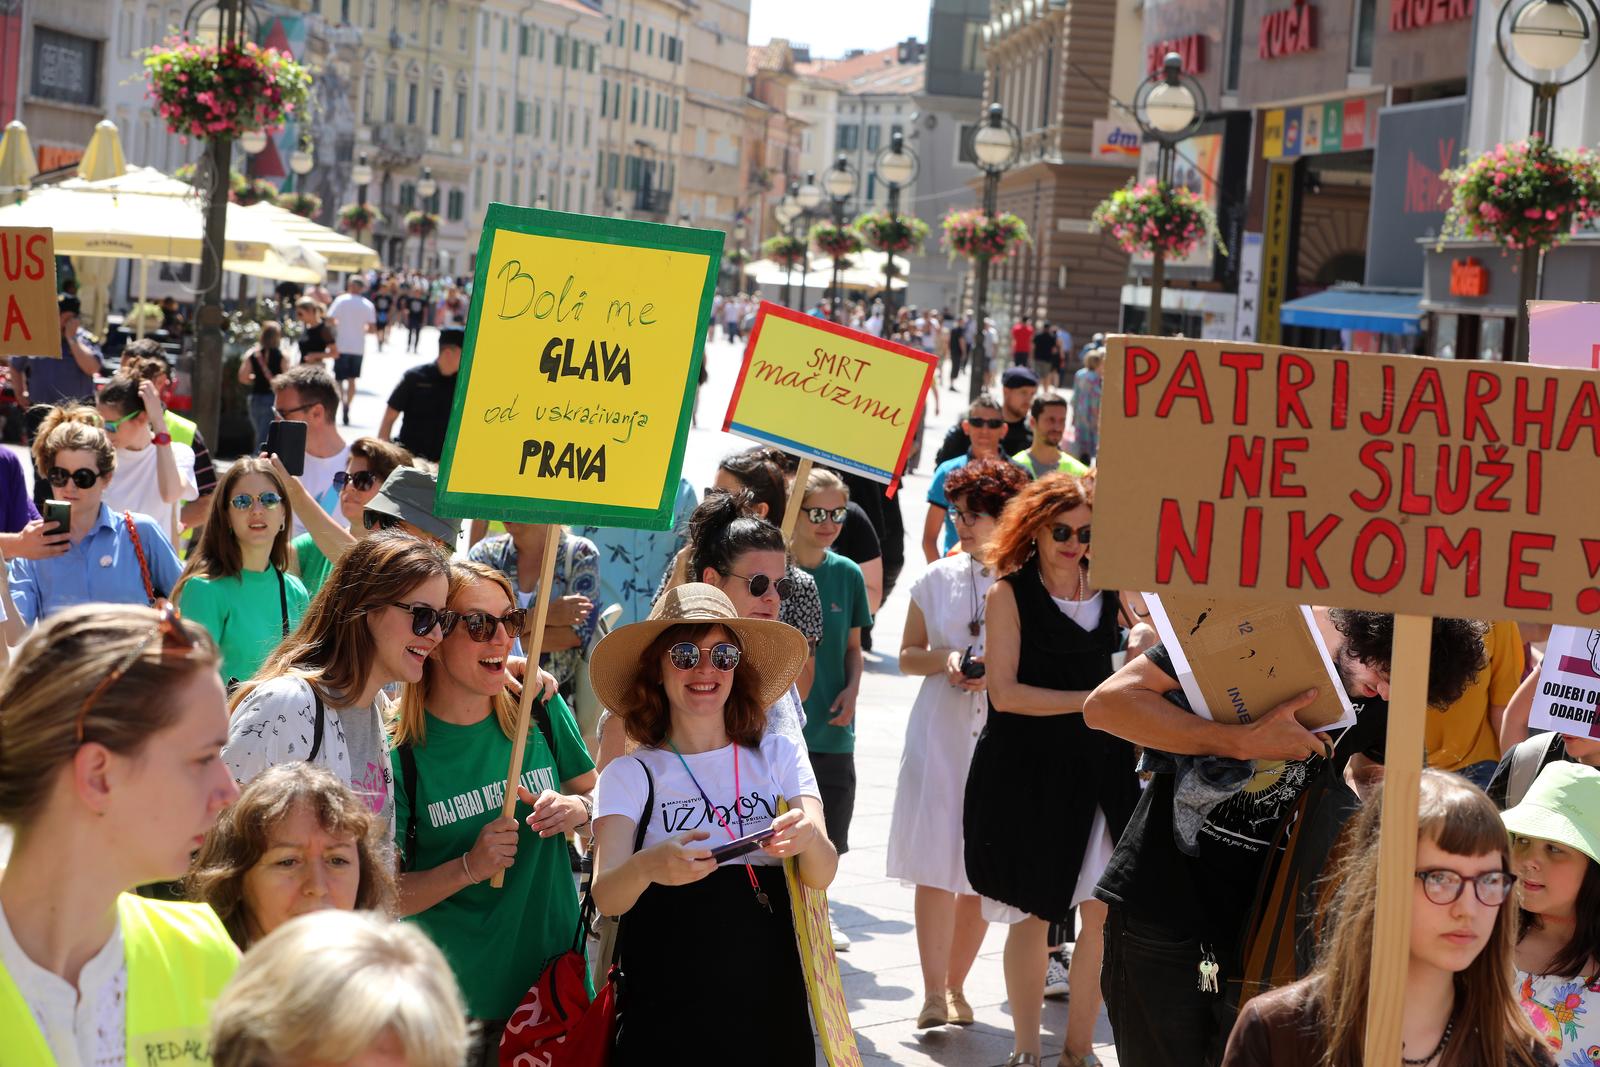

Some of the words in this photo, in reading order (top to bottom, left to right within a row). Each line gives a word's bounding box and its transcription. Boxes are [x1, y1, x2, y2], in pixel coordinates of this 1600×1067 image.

[1107, 127, 1138, 146] dm
[0, 232, 48, 281] US
[497, 259, 588, 323] Boli
[607, 299, 658, 327] me
[539, 336, 632, 386] GLAVA
[806, 347, 872, 383] SMRT
[484, 393, 519, 424] od
[753, 359, 905, 428] mačizmu
[1123, 346, 1600, 458] PATRIJARHA
[518, 439, 606, 483] PRAVA
[1219, 434, 1310, 500] NE
[1349, 439, 1543, 516] SLUŽI
[1155, 498, 1600, 615] NIKOME!
[1238, 620, 1254, 636] 12
[1542, 681, 1586, 703] ODJEBI
[427, 798, 457, 828] OVAJ
[454, 788, 485, 820] GRAD
